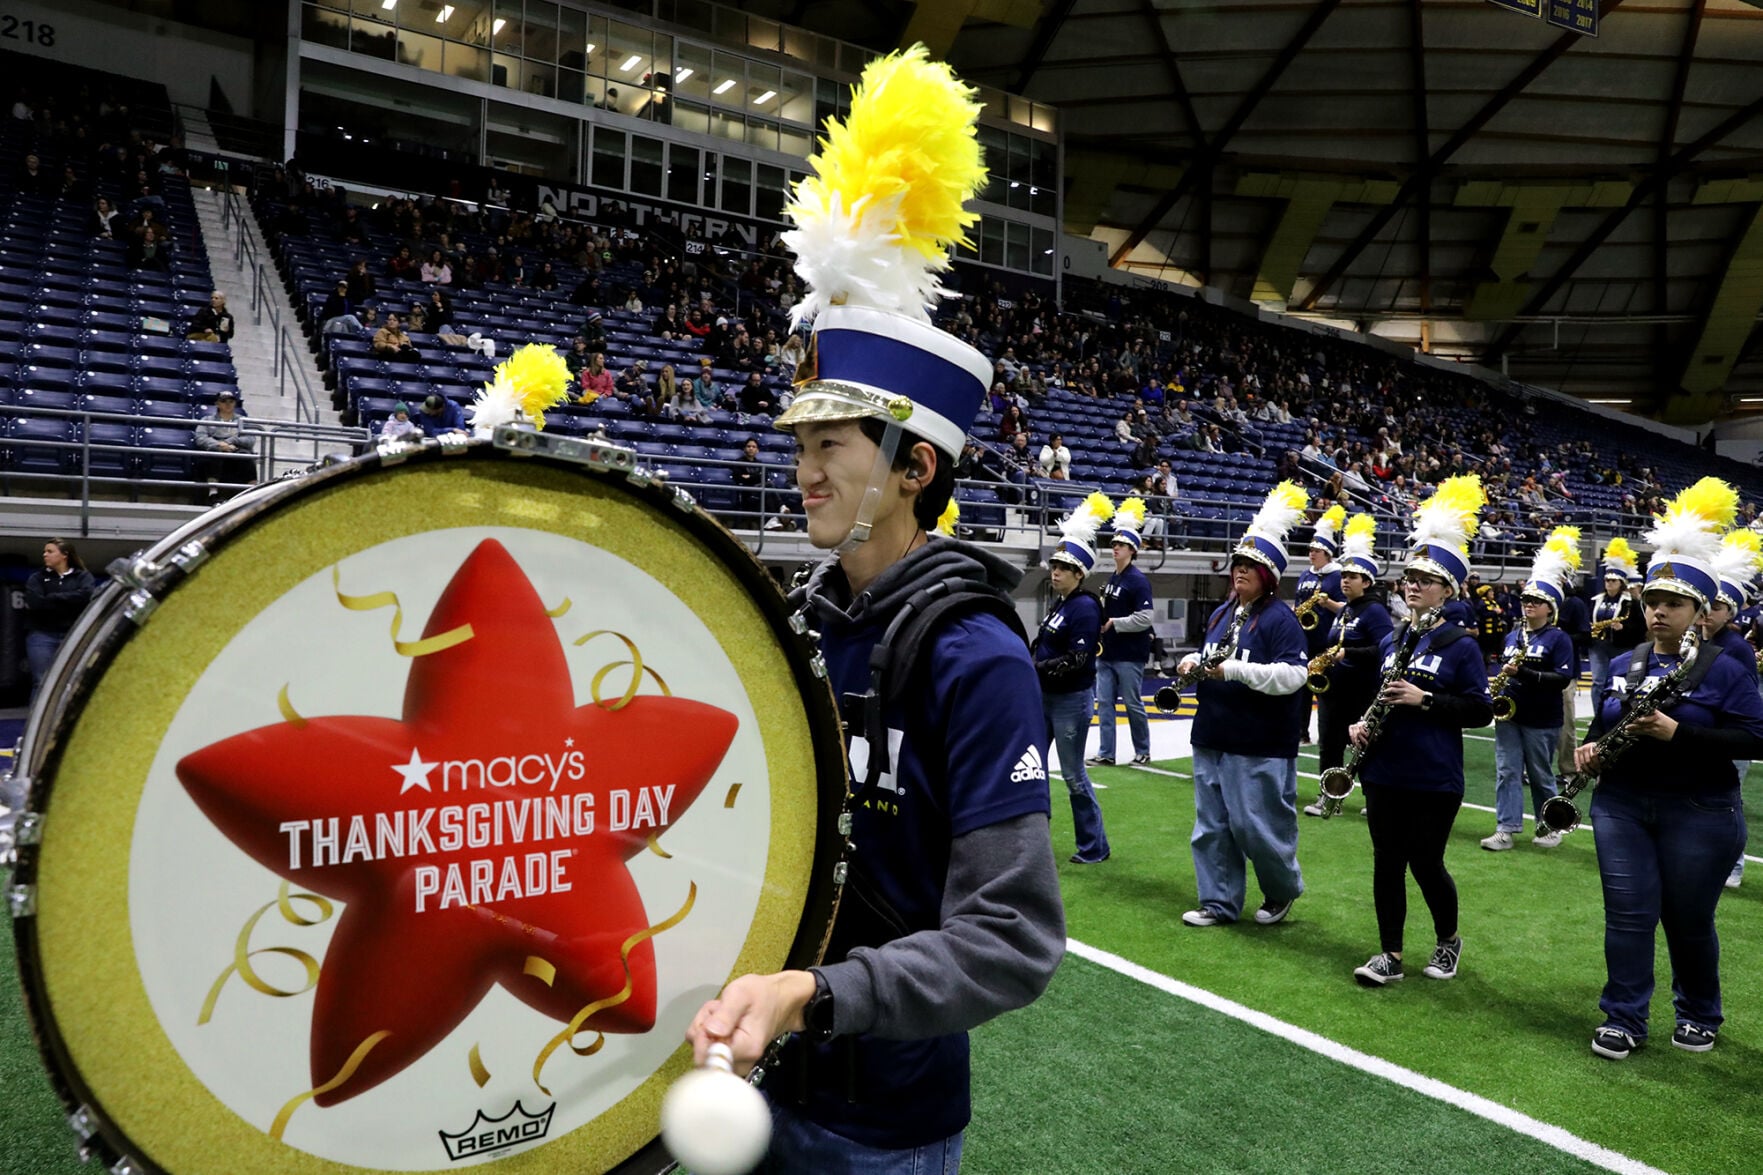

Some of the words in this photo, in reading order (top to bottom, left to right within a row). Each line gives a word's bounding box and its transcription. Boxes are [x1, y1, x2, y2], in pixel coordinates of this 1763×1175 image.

[1, 14, 55, 47] 218
[279, 793, 595, 870] THANKSGIVING
[609, 784, 676, 832] DAY
[415, 849, 573, 913] PARADE
[457, 1120, 540, 1154] REMO
